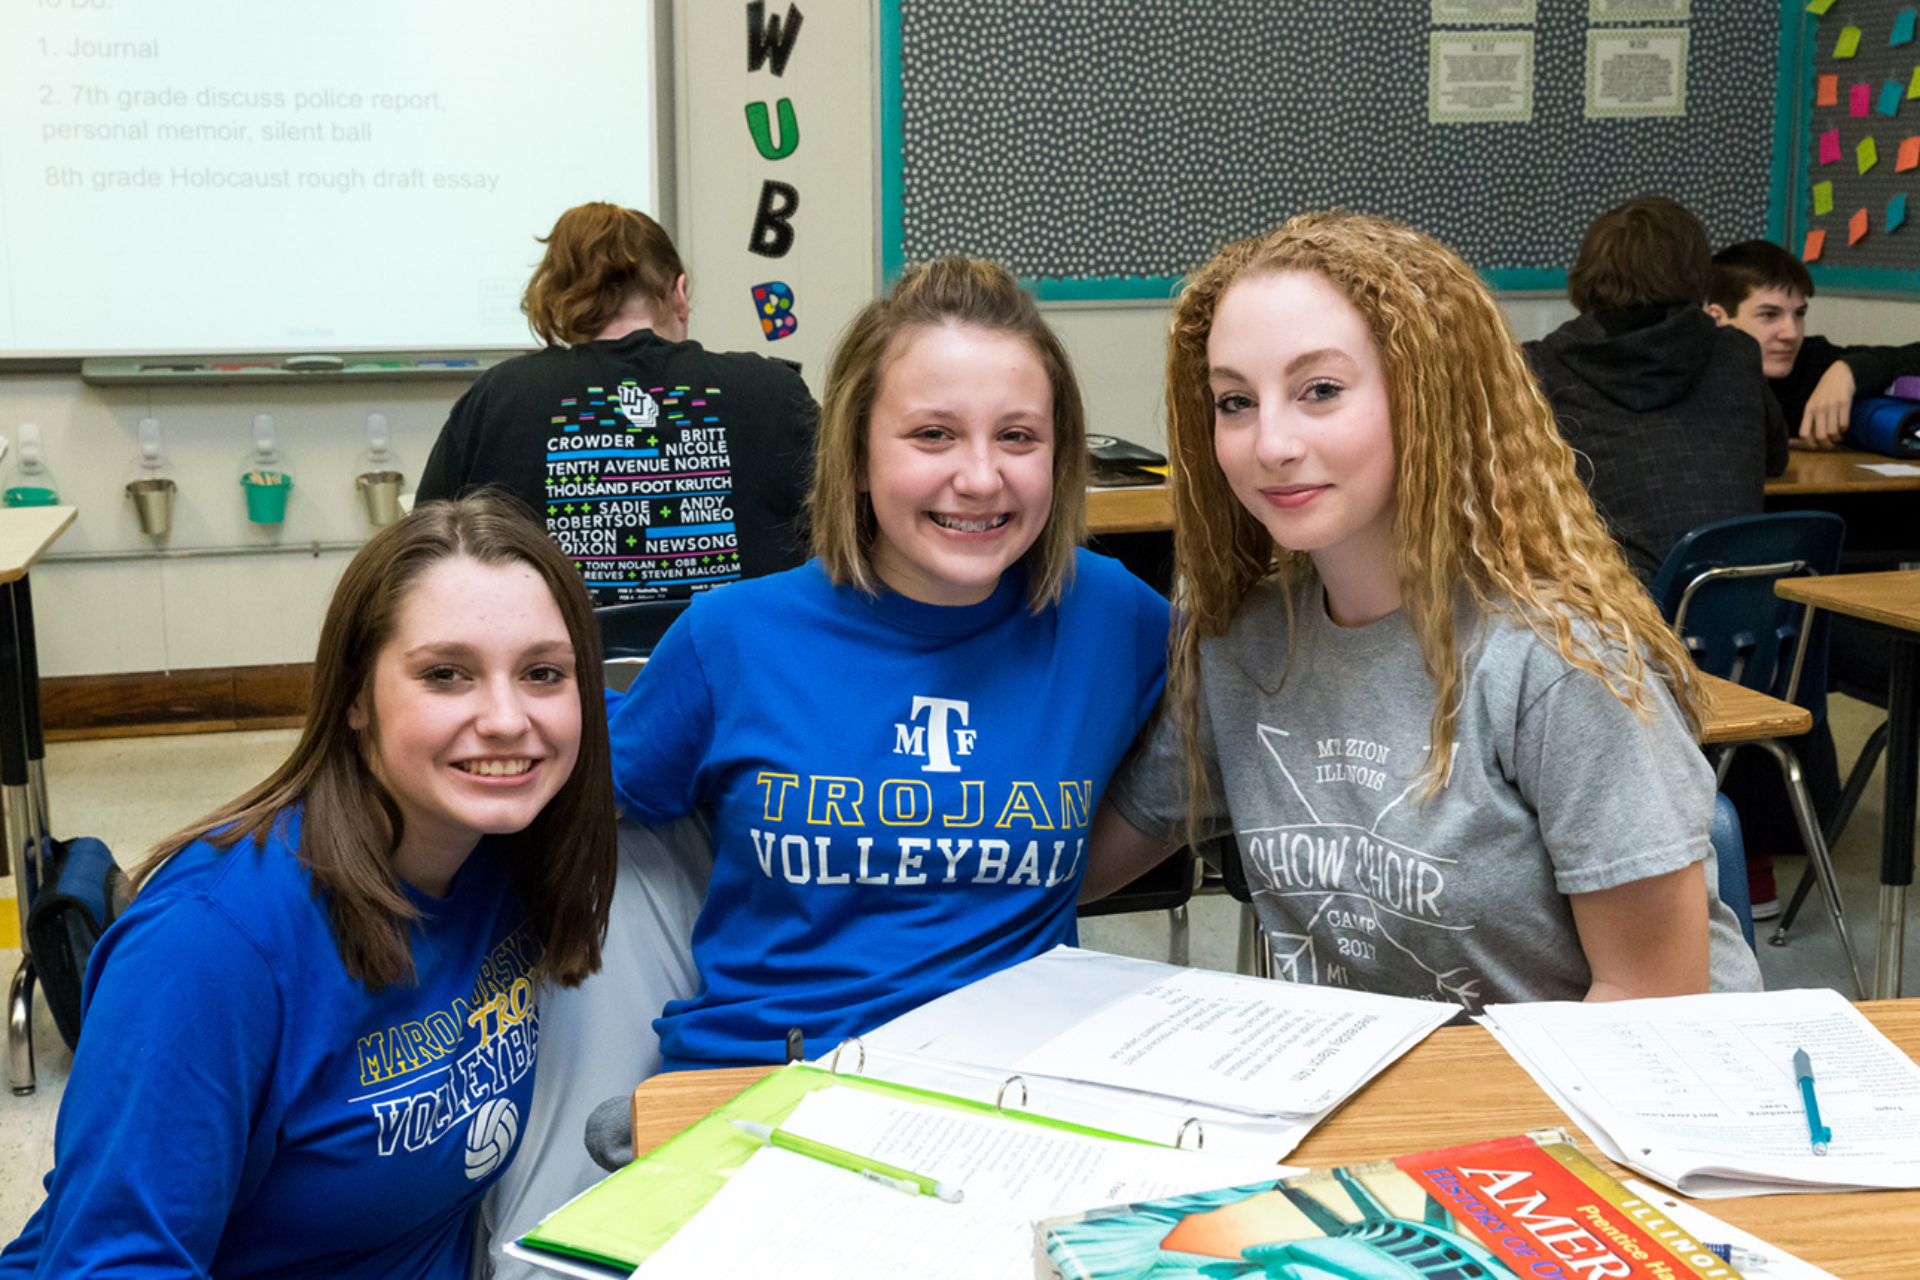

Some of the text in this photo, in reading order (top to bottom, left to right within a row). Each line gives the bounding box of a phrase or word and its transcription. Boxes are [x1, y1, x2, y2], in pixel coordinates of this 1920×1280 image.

[37, 36, 159, 59] 1. Journal
[39, 84, 447, 113] 2. 7th grade discuss police report,
[42, 120, 149, 144] personal
[261, 121, 325, 143] silent
[332, 122, 373, 143] ball
[45, 167, 501, 193] 8th grade Holocaust rough draft essay
[745, 1, 804, 378] WUBB
[547, 434, 635, 451] CROWDER
[681, 428, 726, 442] BRITT
[665, 440, 728, 457] NICOLE
[547, 455, 731, 476] TENTH AVENUE NORTH
[546, 476, 732, 498] THOUSAND FOOT KRUTCH
[600, 501, 650, 515] SADIE
[680, 496, 725, 511] ANDY
[546, 513, 651, 531] ROBERTSON
[681, 508, 734, 524] MINEO
[561, 541, 617, 555] DIXON
[645, 534, 738, 554] NEWSONG
[586, 560, 656, 570] TONY NOLAN
[641, 563, 741, 579] STEVEN MALCOLM
[675, 558, 697, 568] OBB
[584, 570, 624, 580] REEVES
[1345, 738, 1391, 765] ZION
[757, 771, 1092, 830] TROJAN
[750, 828, 1086, 888] VOLLEYBALL
[1250, 832, 1444, 917] SHOW CHOIR
[1327, 910, 1376, 934] CAMP
[1337, 937, 1377, 960] 2017
[1422, 1166, 1569, 1280] HISTORY OF O
[1577, 1204, 1686, 1280] Prentice Ha
[1621, 1200, 1741, 1280] ILLINOI
